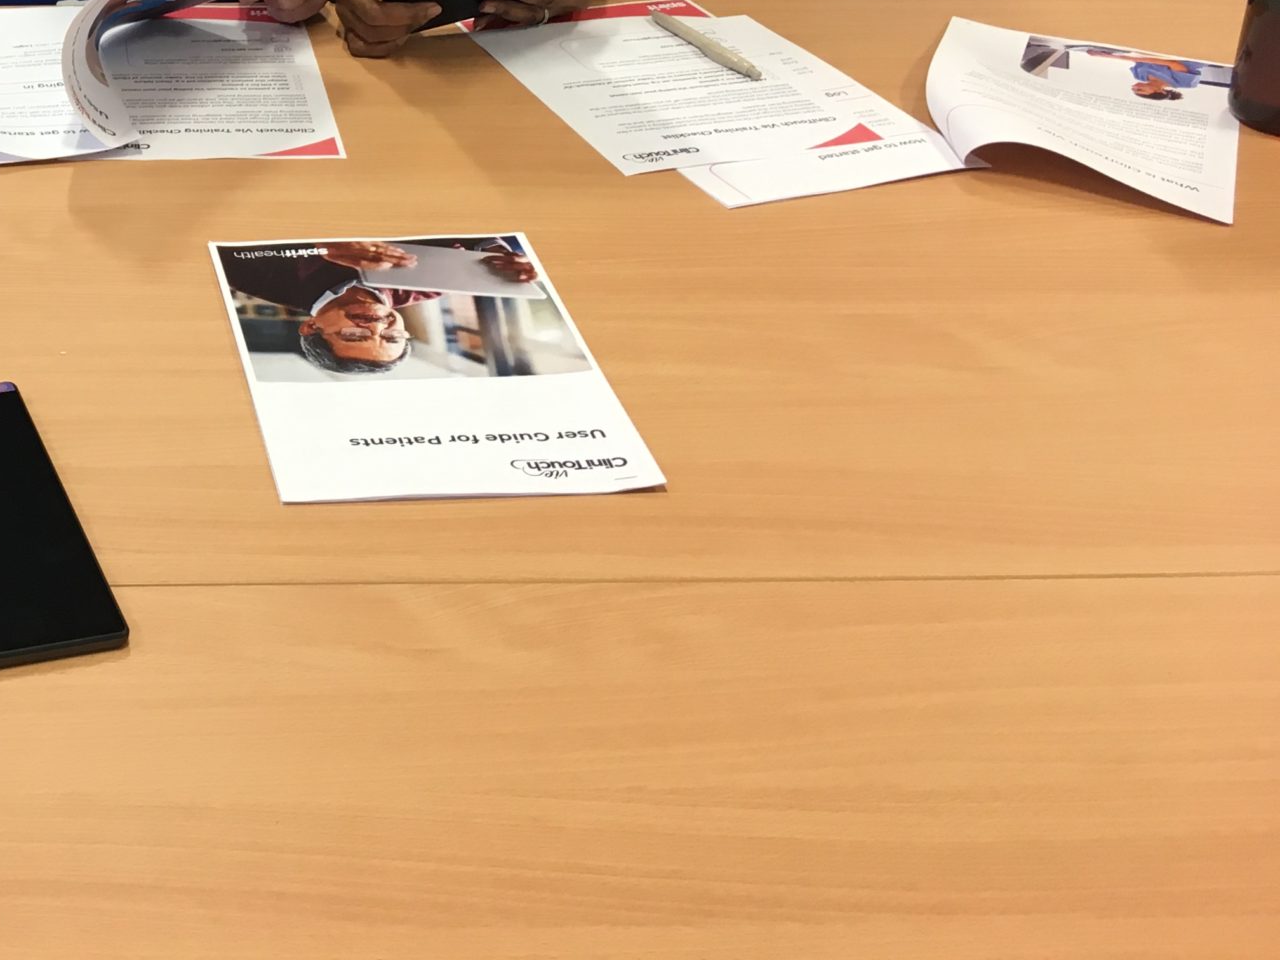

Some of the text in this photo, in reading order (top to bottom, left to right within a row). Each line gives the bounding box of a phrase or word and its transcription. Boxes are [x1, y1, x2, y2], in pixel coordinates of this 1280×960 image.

[233, 247, 329, 259] spirithealth
[349, 429, 607, 447] User Guide for Patients
[526, 457, 628, 471] CliniTouch
